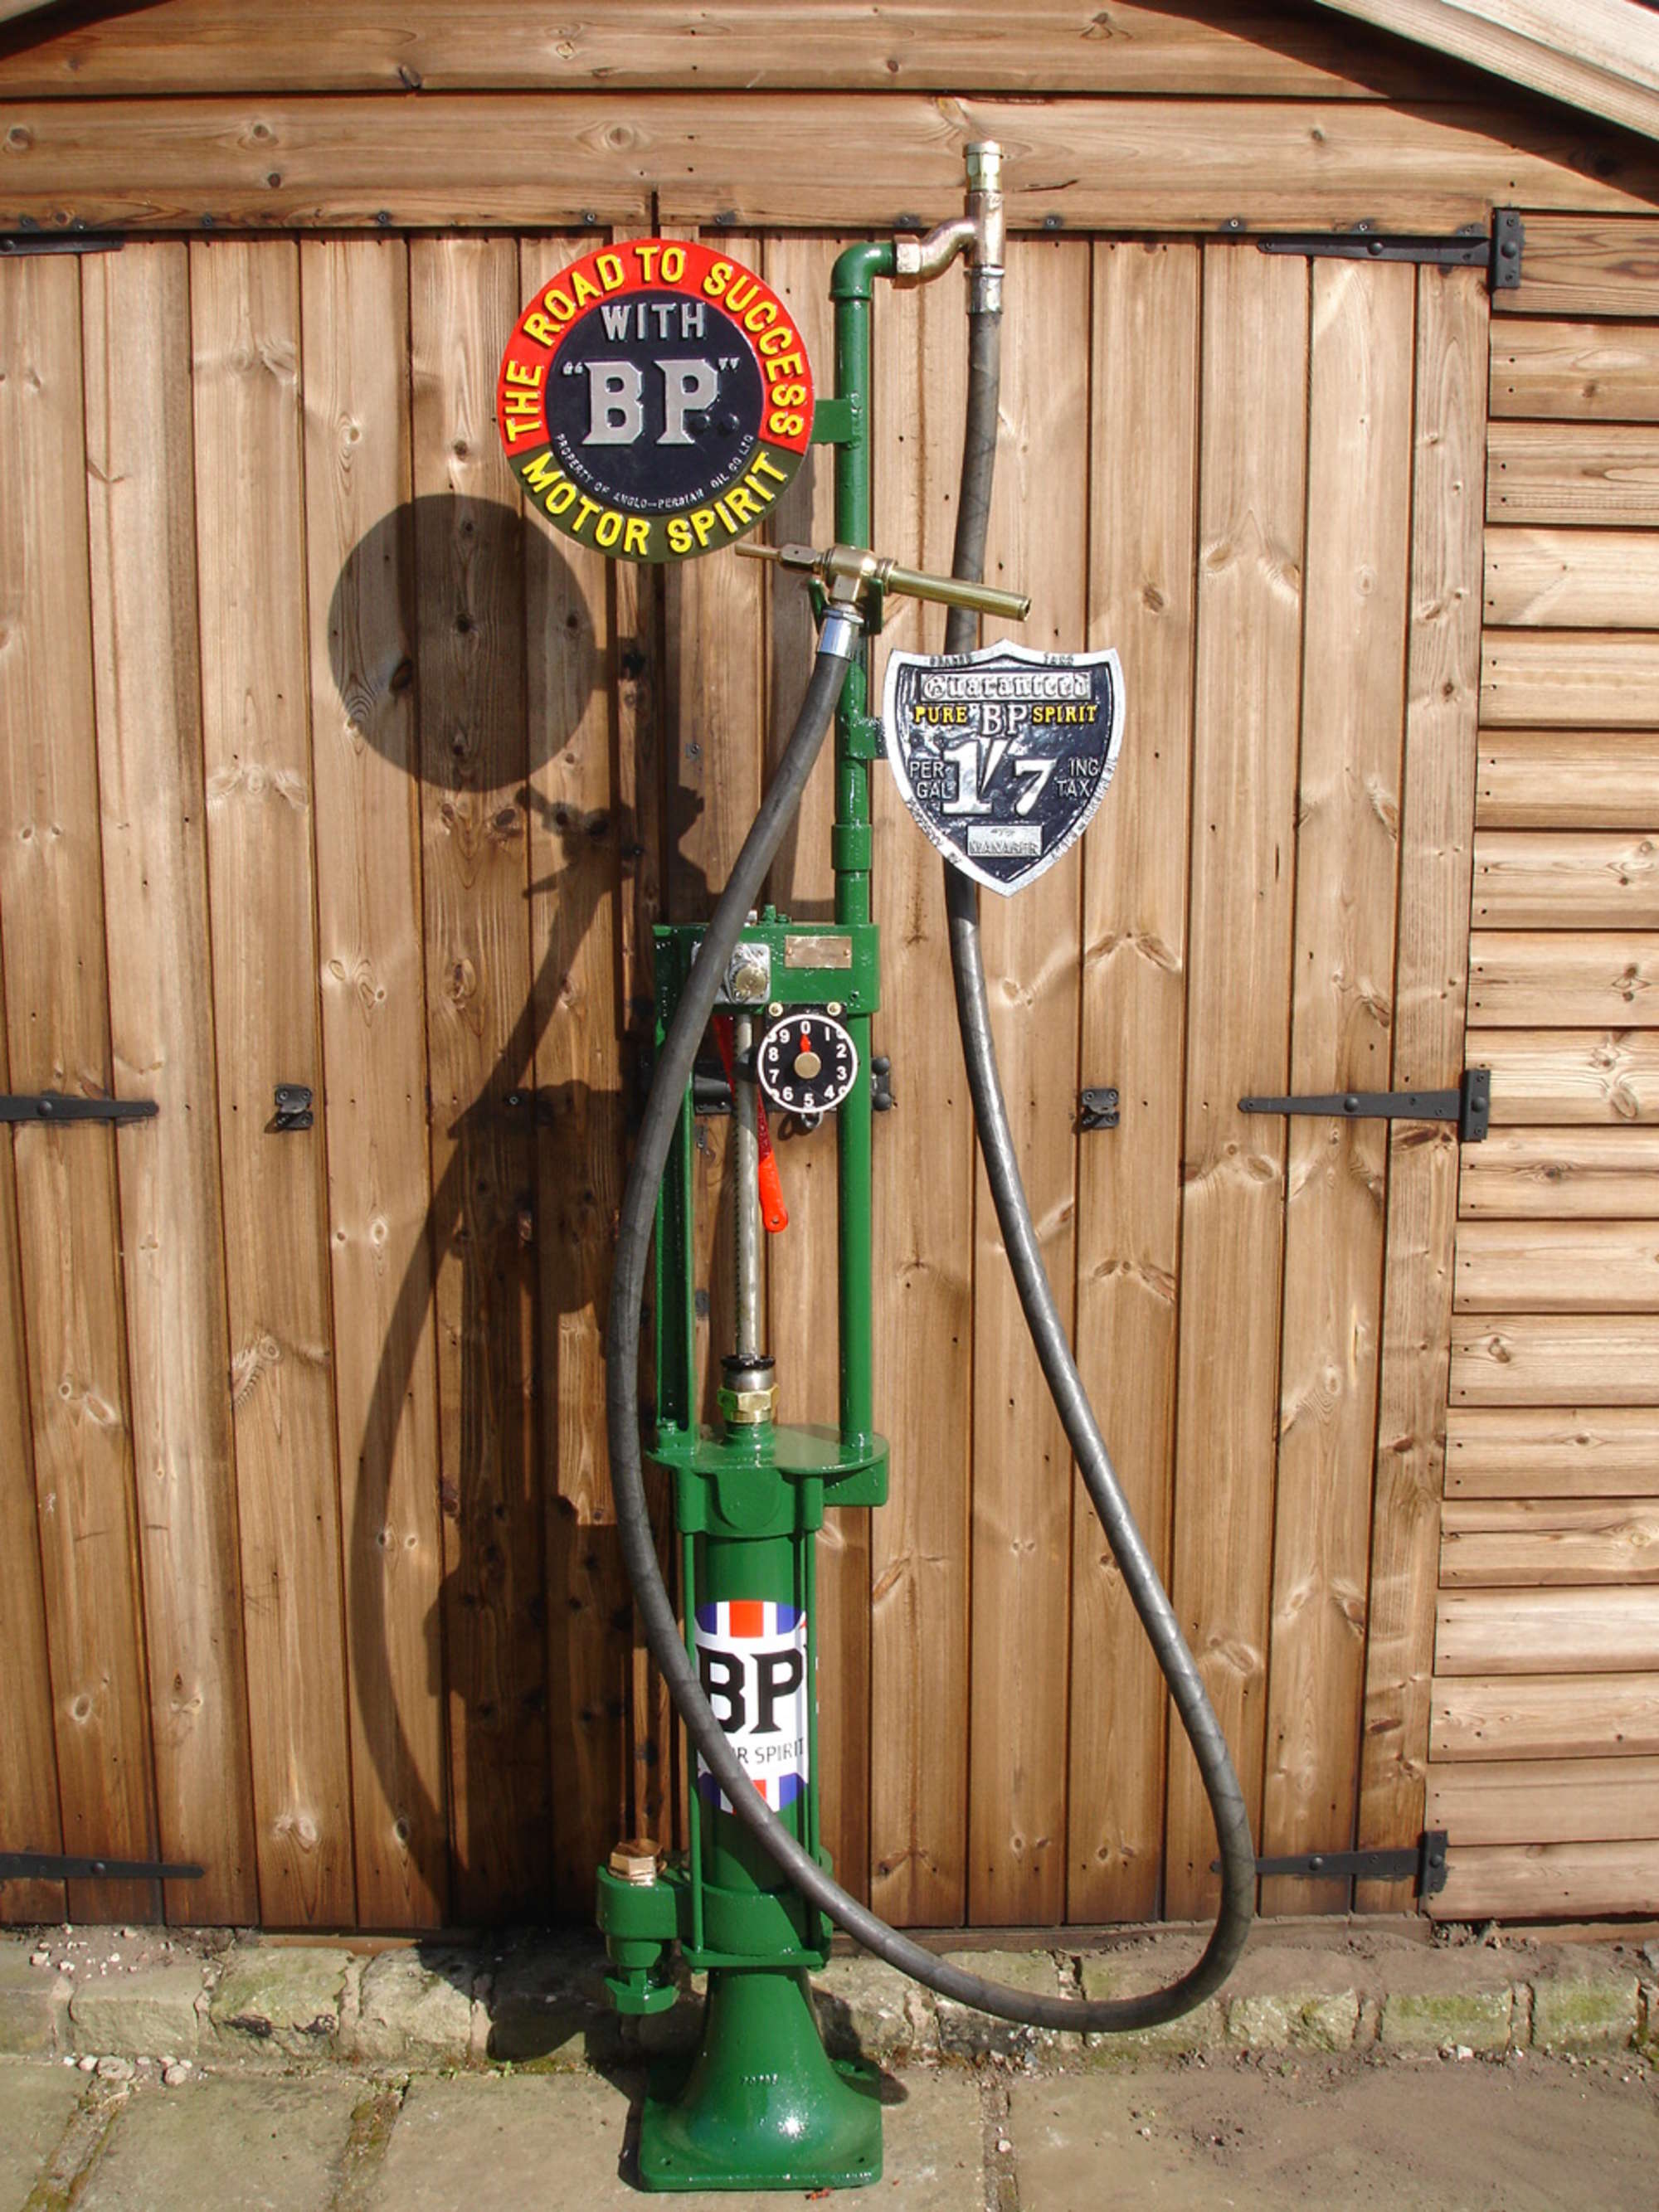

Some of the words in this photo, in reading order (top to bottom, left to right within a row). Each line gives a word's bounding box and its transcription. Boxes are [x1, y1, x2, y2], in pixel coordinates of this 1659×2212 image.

[635, 246, 686, 283] TO
[523, 253, 625, 347] ROAD
[601, 302, 707, 341] WITH
[703, 261, 807, 437] SUCCESS
[504, 359, 545, 443] THE
[555, 433, 595, 484] PROPERTY
[593, 481, 611, 494] OF
[710, 473, 730, 489] OIL
[521, 450, 650, 556] MOTOR
[667, 450, 788, 553] SPIRIT
[922, 673, 1090, 699] Guaranteed
[914, 705, 967, 723] PURE
[1033, 705, 1097, 723] SPIRIT
[909, 761, 945, 778] PER
[941, 736, 1058, 815] 1/7
[917, 781, 951, 799] GAL
[779, 1028, 791, 1044] 9
[800, 1020, 811, 1035] 0
[824, 1026, 831, 1042] 1
[768, 1046, 779, 1062] 8
[835, 1043, 847, 1058] 2
[768, 1068, 780, 1084] 7
[836, 1065, 848, 1081] 3
[782, 1086, 794, 1101] 6
[804, 1093, 815, 1106] 5
[824, 1084, 835, 1100] 4
[697, 1644, 803, 1734] BP
[754, 1738, 803, 1764] SPIRIT
